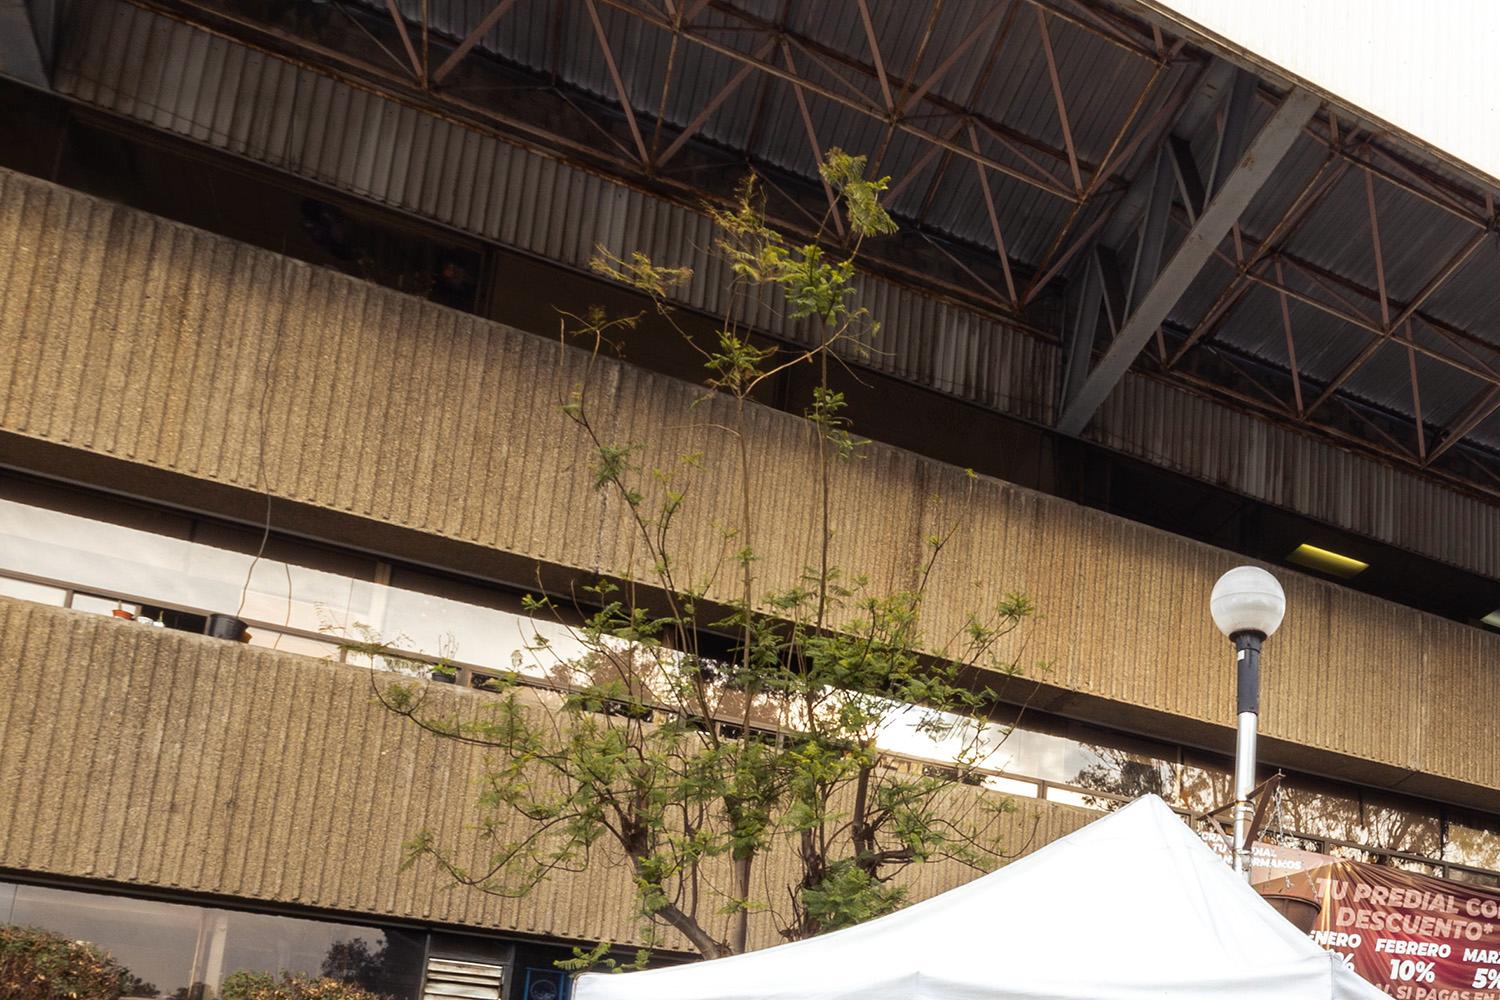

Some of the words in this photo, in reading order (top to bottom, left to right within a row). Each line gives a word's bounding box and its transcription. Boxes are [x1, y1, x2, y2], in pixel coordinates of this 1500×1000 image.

[1316, 878, 1349, 900] TU
[1353, 884, 1460, 914] PREDIAL
[1375, 938, 1452, 958] FEBRERO
[1389, 959, 1436, 983] 10%
[1397, 986, 1413, 1000] SI
